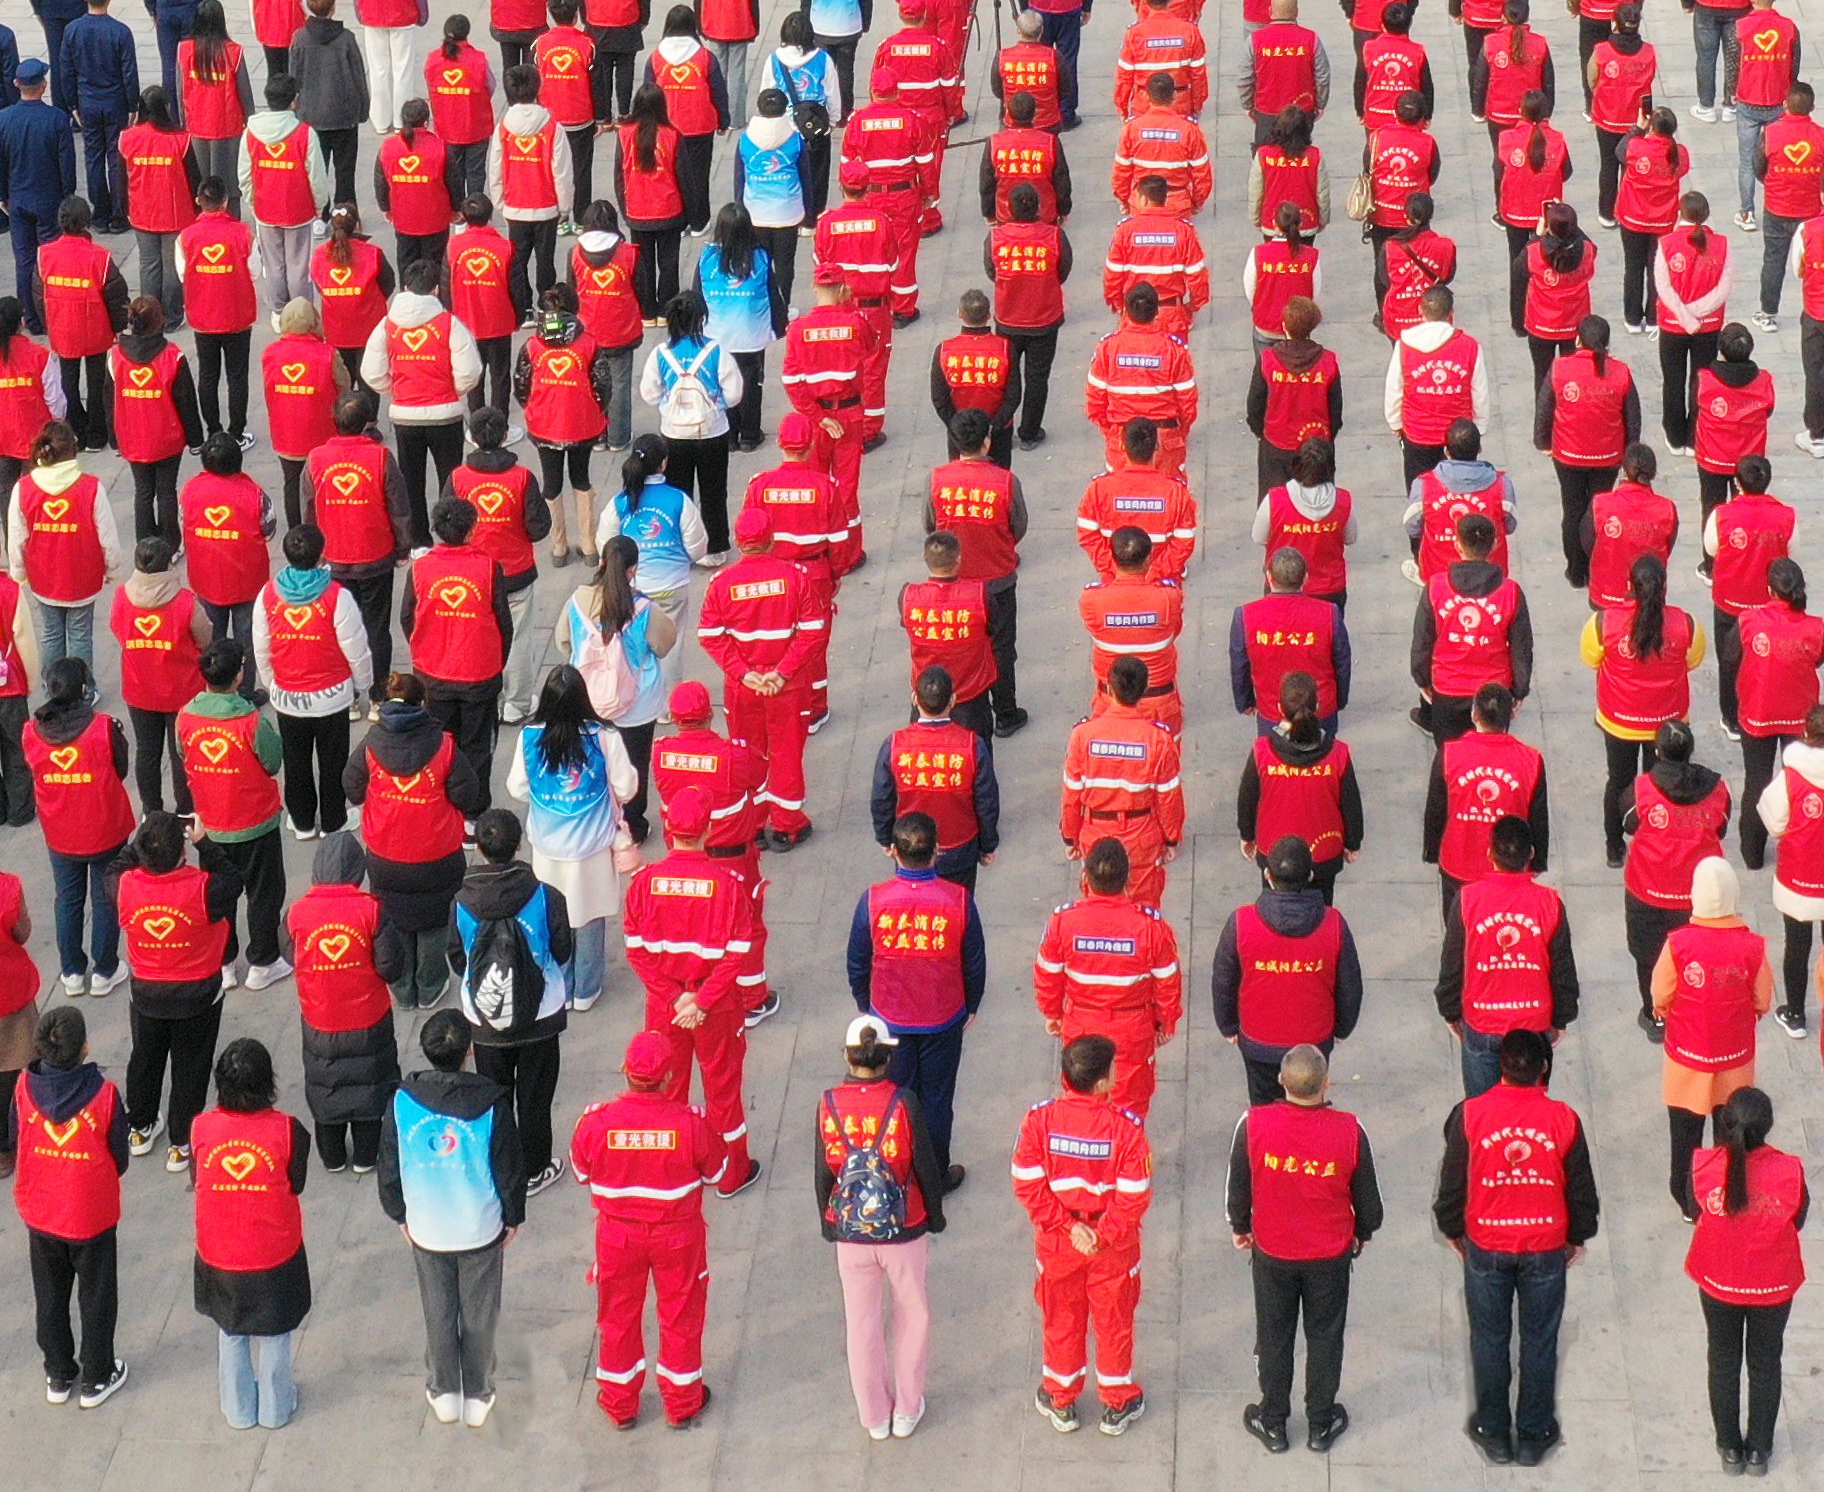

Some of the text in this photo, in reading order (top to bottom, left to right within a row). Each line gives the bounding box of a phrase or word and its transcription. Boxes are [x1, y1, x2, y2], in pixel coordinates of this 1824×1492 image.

[1262, 46, 1305, 57] 阳光公益
[1005, 62, 1048, 73] 新泰消防
[1005, 75, 1048, 85] 公益宣传
[996, 150, 1043, 162] 新泰消防
[1265, 157, 1309, 167] 阳光公益
[997, 162, 1043, 173] 公益宣传
[998, 248, 1046, 259] 新泰消防
[999, 261, 1047, 271] 公益宣传
[1263, 263, 1309, 273] 阳光公益
[47, 276, 89, 288] 消防志愿者
[947, 357, 1000, 369] 新泰消防
[948, 372, 1000, 384] 公益宣传
[1272, 372, 1324, 384] 阳光公益
[122, 389, 162, 399] 消防志愿者
[275, 384, 315, 395] 消防志愿者
[940, 489, 998, 503] 新泰消防
[942, 506, 995, 519] 公益宣传
[34, 523, 78, 533] 消防志愿者
[195, 528, 239, 540] 消防志愿者
[910, 610, 971, 623] 新泰消防
[913, 625, 972, 640] 公益宣传
[1256, 632, 1315, 645] 阳光公益
[126, 640, 171, 651] 消防志愿者
[898, 755, 963, 769] 新泰消防
[43, 772, 91, 784] 消防志愿者
[900, 773, 962, 787] 公益宣传
[878, 915, 947, 932] 新泰消防
[881, 935, 946, 949] 公益宣传
[1265, 1154, 1336, 1176] 阳光公益
